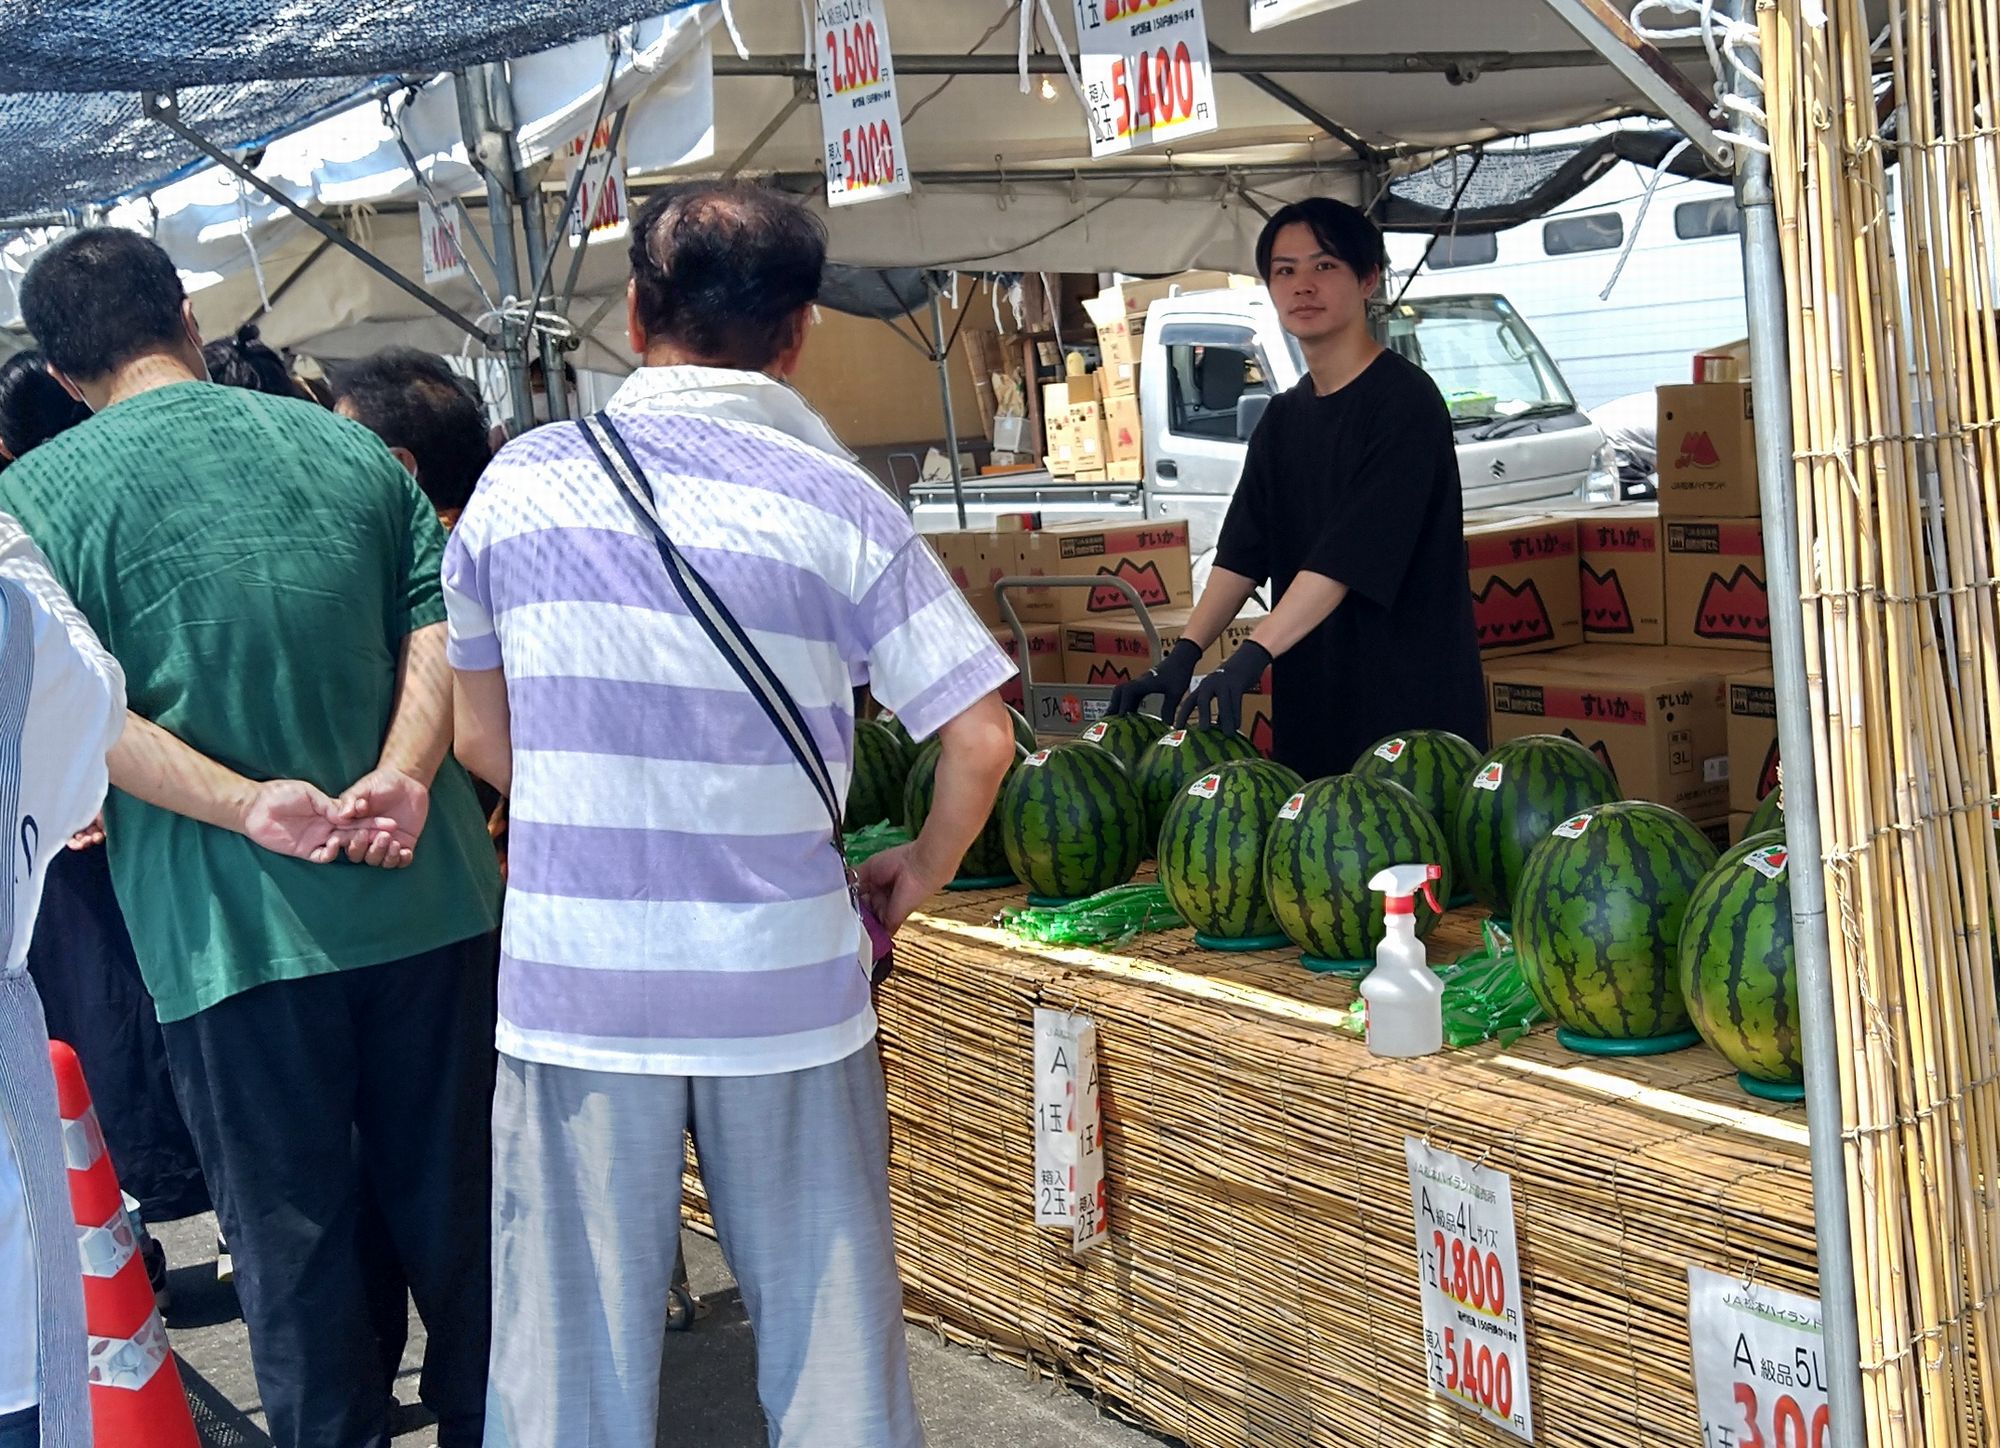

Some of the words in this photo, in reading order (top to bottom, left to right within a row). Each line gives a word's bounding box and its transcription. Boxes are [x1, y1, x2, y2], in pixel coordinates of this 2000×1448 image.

[826, 19, 879, 93] 2,600
[1111, 41, 1194, 136] 5,400
[1197, 102, 1209, 120] 円
[843, 119, 894, 191] 5,000
[1136, 529, 1175, 549] すいか
[1508, 533, 1559, 560] すいか
[1597, 526, 1640, 548] すいか
[1580, 693, 1631, 719] すいか
[1656, 690, 1694, 711] すいか
[1672, 750, 1690, 766] 3L
[1039, 1104, 1063, 1133] 1玉
[1080, 1124, 1094, 1158] 1玉
[1041, 1170, 1065, 1187] 箱入
[1041, 1187, 1067, 1217] 2玉
[1421, 1184, 1499, 1250] A級品4Lサイズ
[1078, 1209, 1095, 1244] 2玉
[1420, 1248, 1437, 1289] 1玉
[1433, 1230, 1505, 1317] 2,800
[1506, 1308, 1517, 1327] 円
[1427, 1349, 1446, 1388] 2玉
[1443, 1326, 1513, 1419] 5,400
[1513, 1413, 1525, 1431] 円
